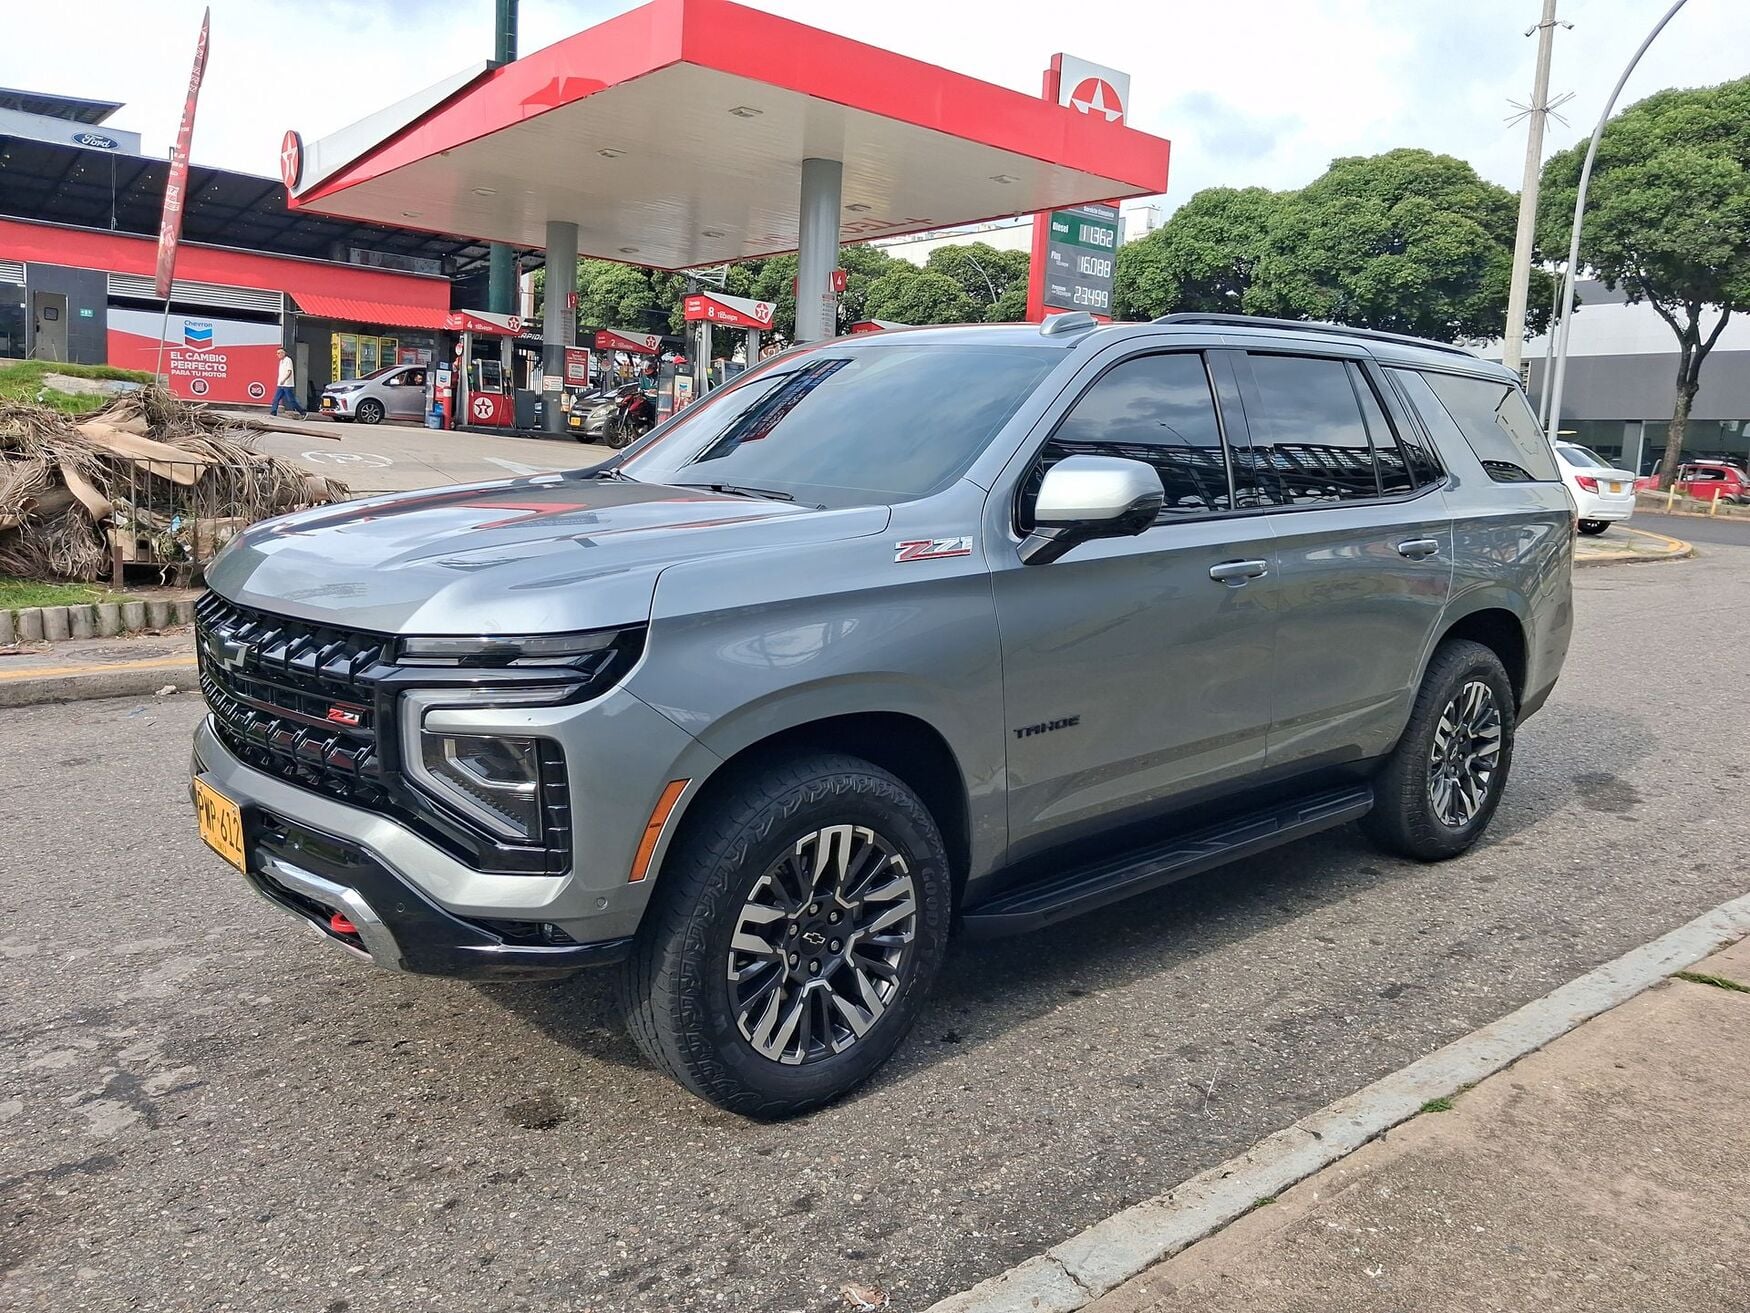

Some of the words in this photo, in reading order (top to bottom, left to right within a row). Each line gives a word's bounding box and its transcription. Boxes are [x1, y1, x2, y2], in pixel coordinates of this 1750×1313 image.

[81, 133, 111, 148] Ford
[1052, 221, 1069, 233] Diesel
[836, 275, 842, 286] 4
[708, 306, 715, 317] 8
[184, 320, 213, 328] Chevron
[466, 320, 473, 329] 4
[610, 339, 616, 347] 2
[171, 351, 183, 360] EL
[185, 352, 227, 362] CAMBIO
[170, 360, 227, 371] PERFECTO
[894, 535, 973, 563] Z71
[1013, 714, 1081, 739] TAHOE
